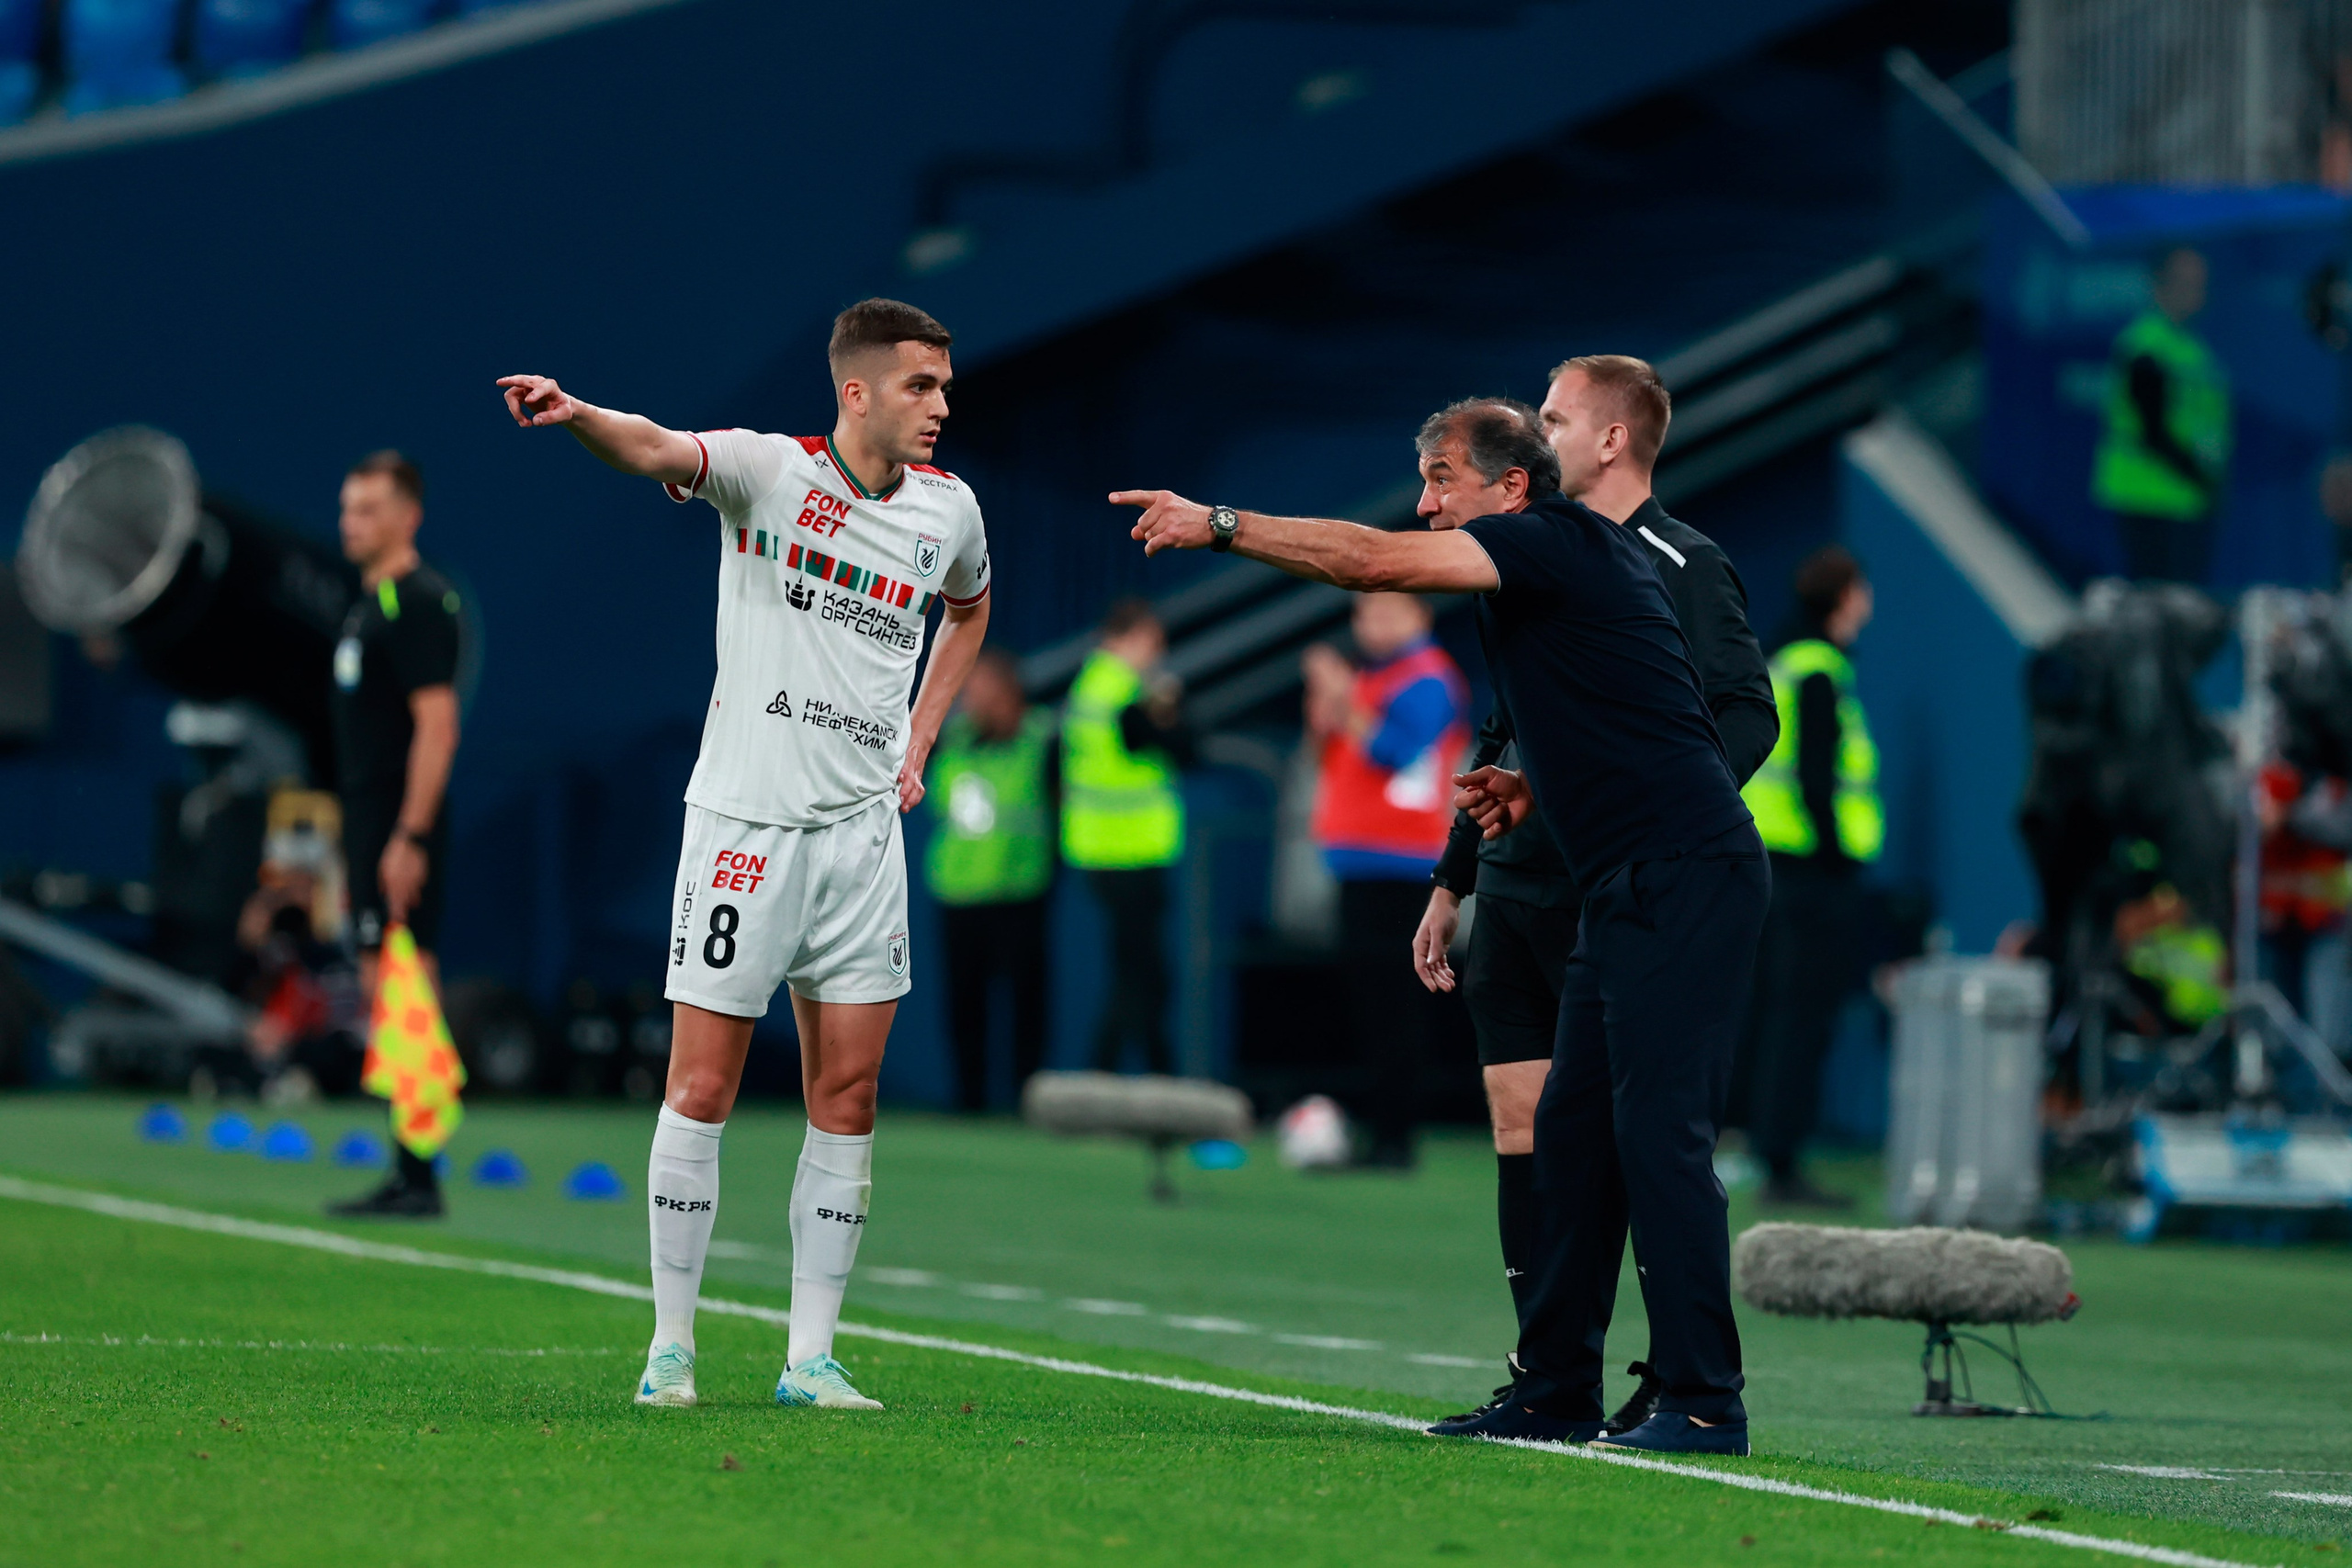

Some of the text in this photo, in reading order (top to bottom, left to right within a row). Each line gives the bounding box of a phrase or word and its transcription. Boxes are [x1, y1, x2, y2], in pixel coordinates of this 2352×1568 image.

[803, 489, 852, 521] FON
[796, 507, 846, 538] BET
[918, 533, 943, 545] РУБИН
[823, 589, 900, 630] КАЗАНЬ
[820, 606, 917, 650] ОРГСИНТЕЗ
[805, 698, 899, 742] НИНЕКАМСК
[714, 850, 768, 874] FON
[711, 869, 764, 895] BET
[703, 904, 740, 969] 8
[654, 1195, 711, 1212] ФКРК
[817, 1207, 866, 1225] ФКР
